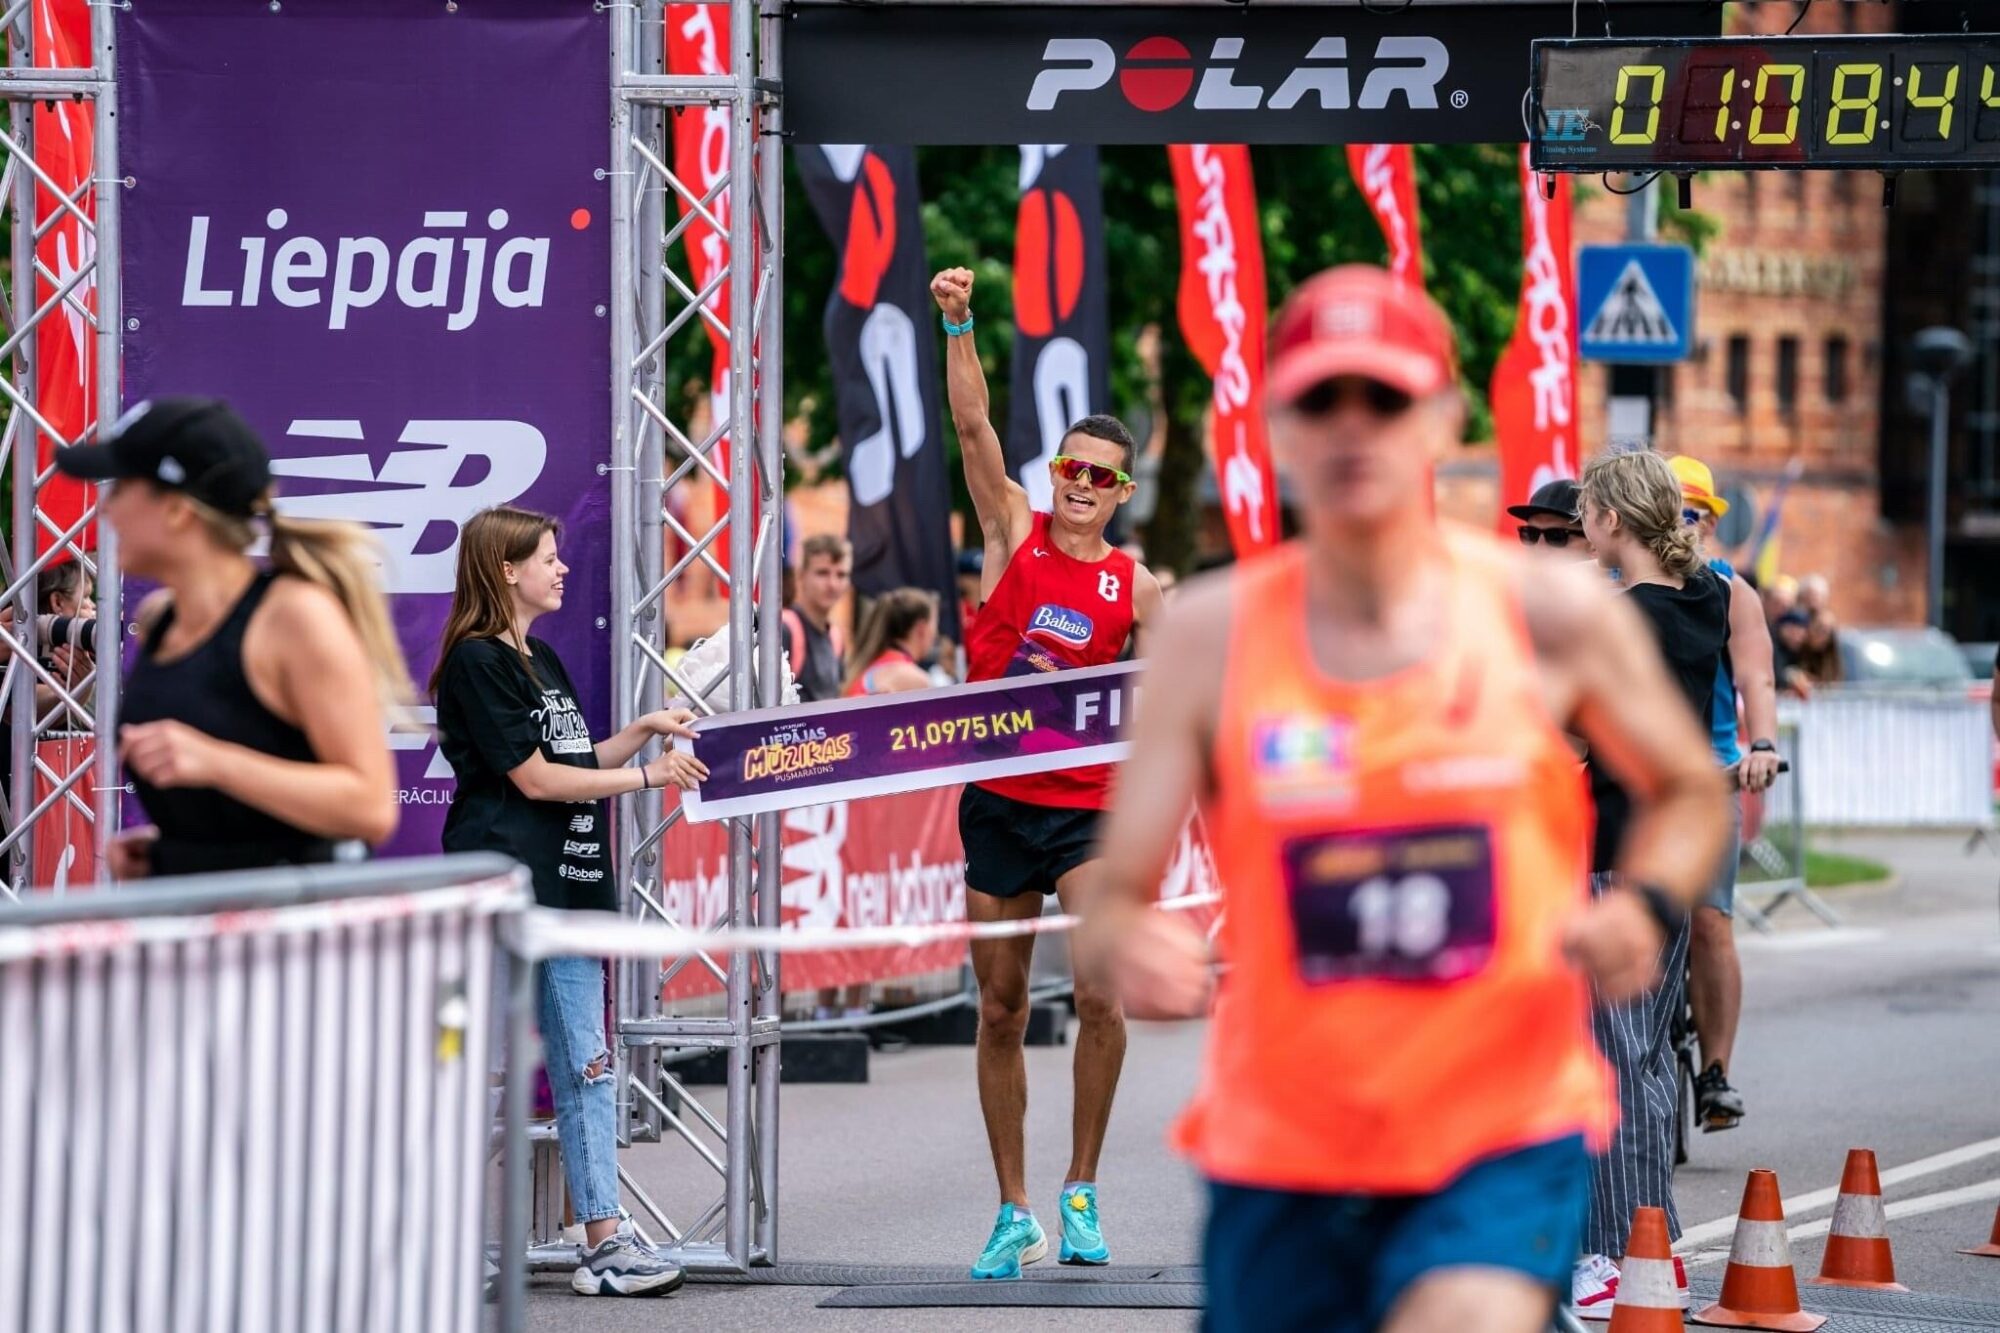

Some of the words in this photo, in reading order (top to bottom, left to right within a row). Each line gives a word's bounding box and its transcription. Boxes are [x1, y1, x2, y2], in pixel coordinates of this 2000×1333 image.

[1541, 145, 1566, 153] Timing
[1568, 145, 1597, 154] Systems
[182, 208, 551, 331] Liepāja
[1034, 606, 1089, 637] Baltais
[760, 726, 827, 748] LIEPĀJAS
[890, 715, 987, 752] 21,0975
[991, 709, 1034, 737] KM
[775, 764, 834, 782] PUSMARATONS
[391, 786, 454, 805] ERĀCIJU
[563, 839, 601, 855] LSFP
[567, 865, 604, 879] Dobele
